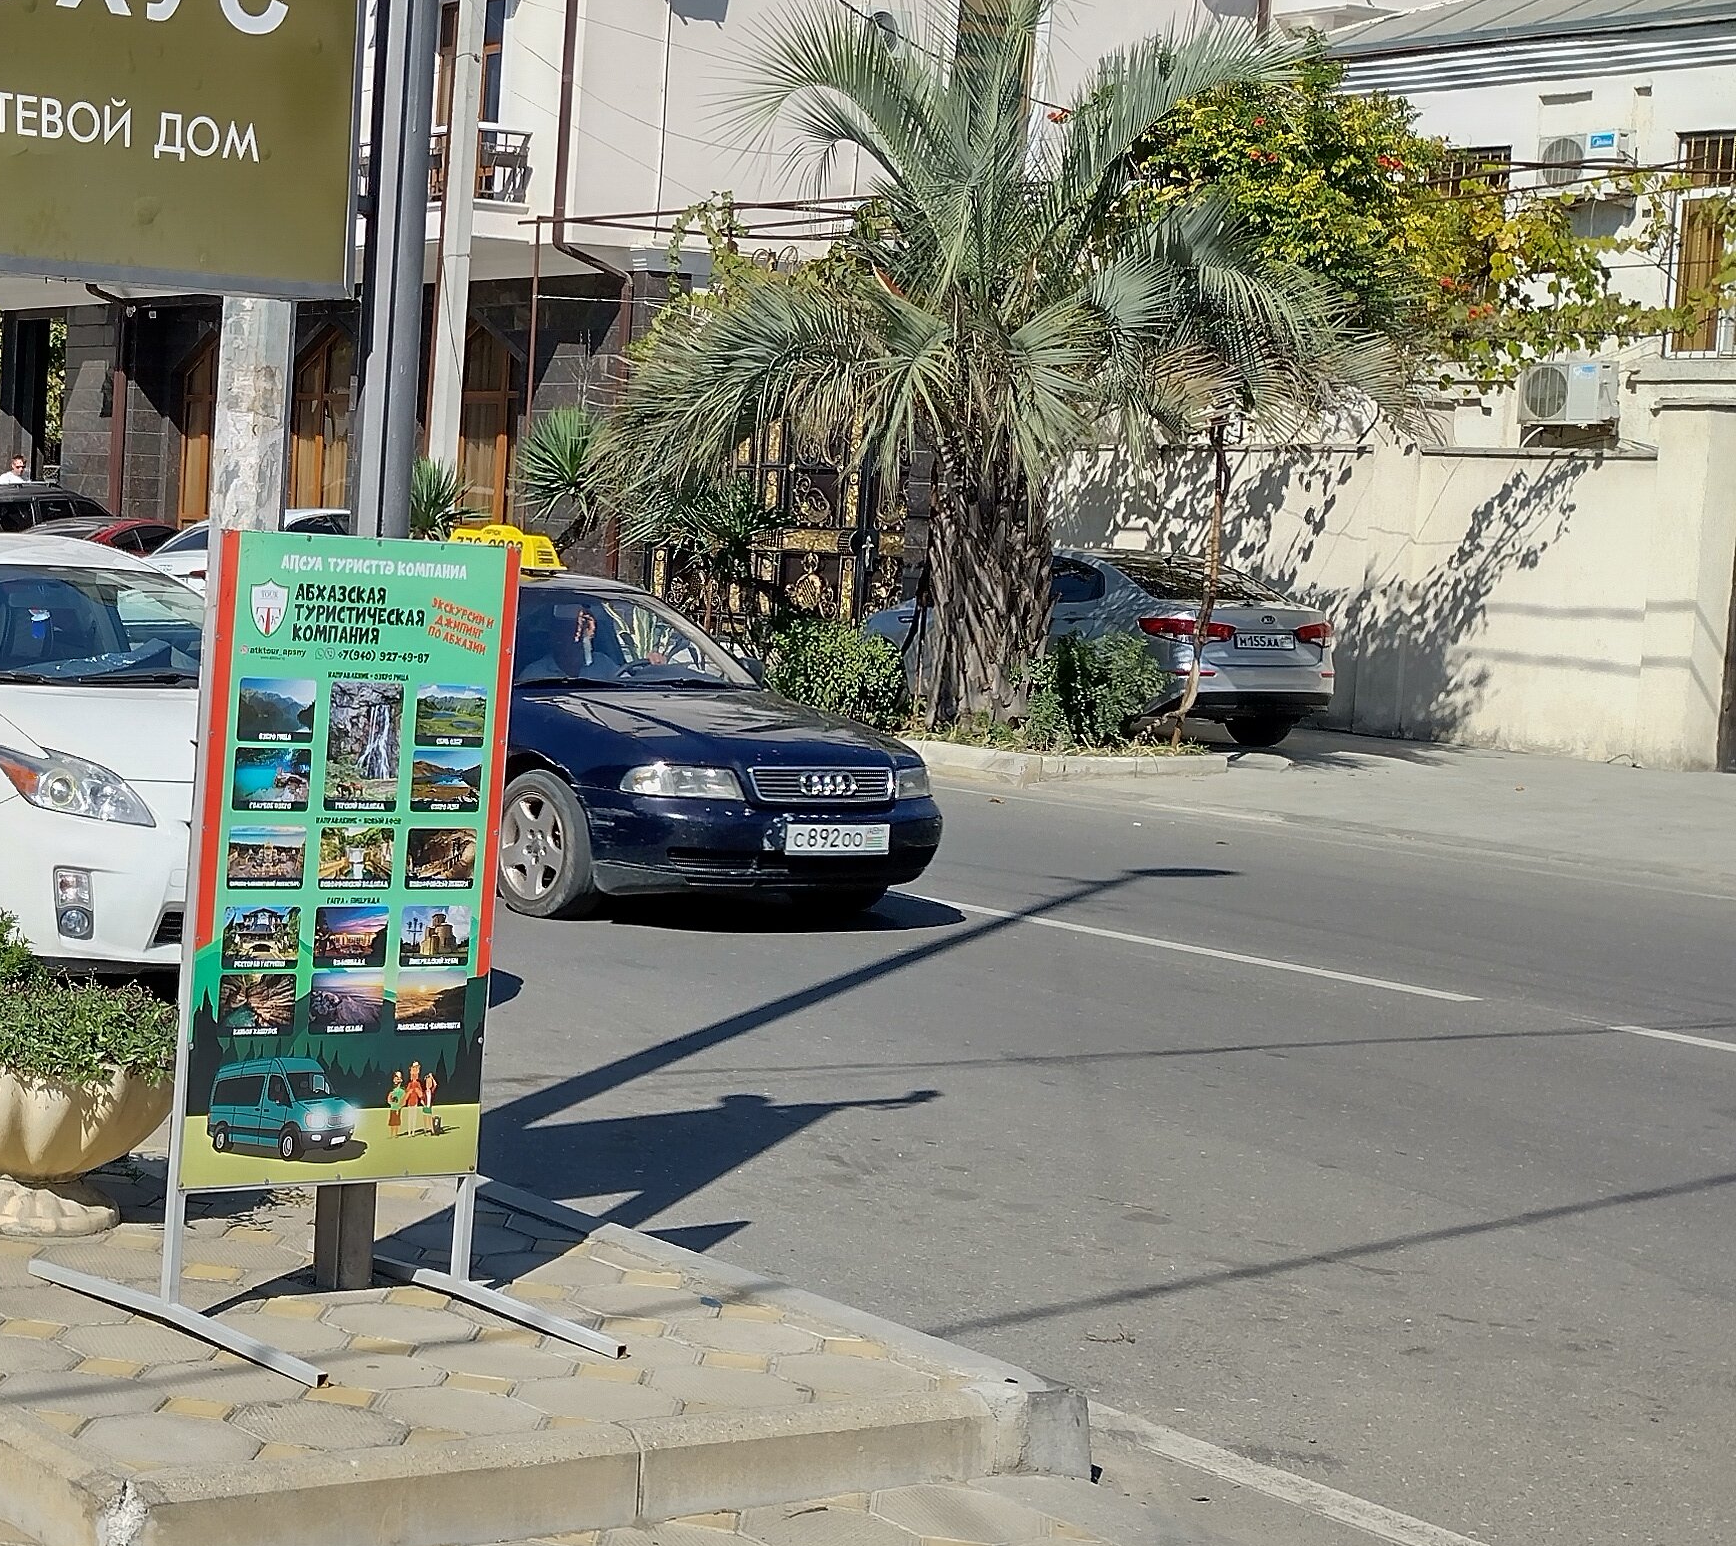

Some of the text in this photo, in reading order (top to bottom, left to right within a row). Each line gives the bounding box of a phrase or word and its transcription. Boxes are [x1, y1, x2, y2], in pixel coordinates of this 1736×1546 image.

[153, 112, 261, 164] ДОМ
[294, 583, 387, 605] АБХАЗСКАЯ
[293, 604, 426, 627] ТУРИСТИЧЕСКАЯ
[431, 597, 495, 630] ЭКСКУРСИИ И
[291, 623, 381, 645] КОМПАНИЯ
[434, 614, 484, 640] ДЖИПИНГ
[427, 625, 487, 656] ПО АБХАЗИИ
[379, 651, 430, 664] 927-49-87
